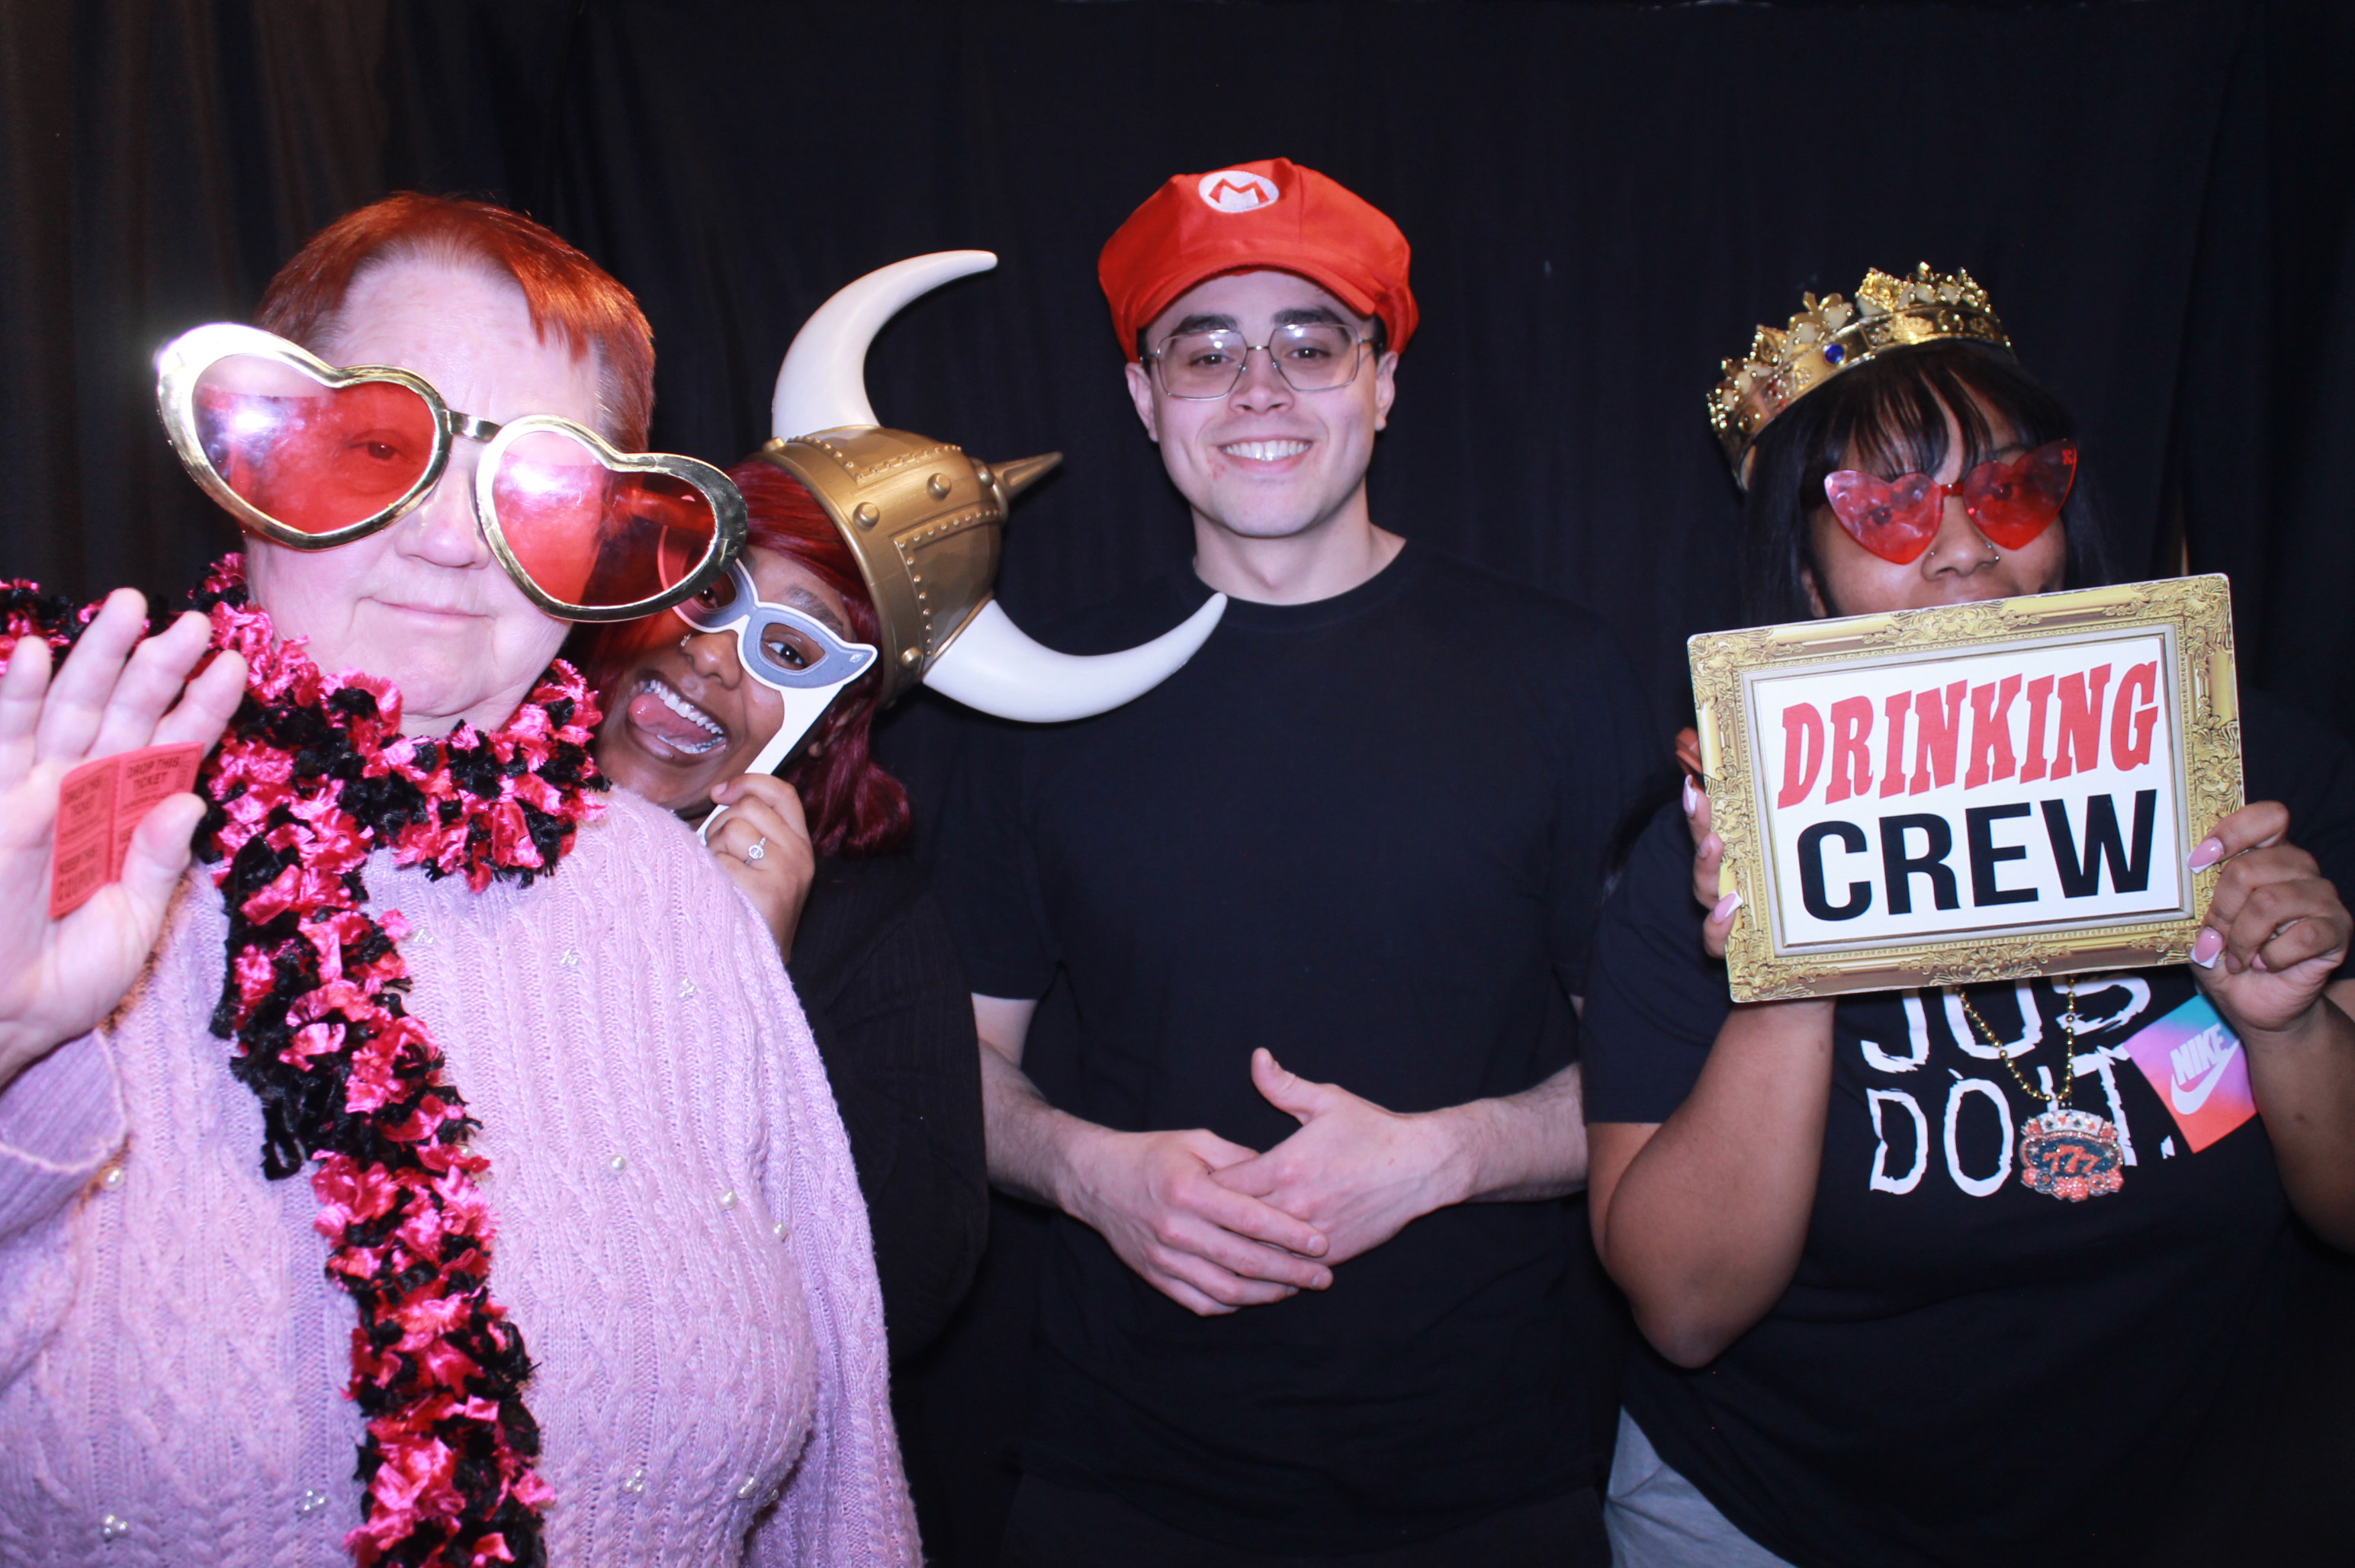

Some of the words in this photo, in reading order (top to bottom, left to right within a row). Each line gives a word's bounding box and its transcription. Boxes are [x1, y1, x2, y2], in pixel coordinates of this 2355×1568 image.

[1209, 178, 1270, 204] M
[1778, 660, 2159, 809] DRINKING
[1797, 789, 2157, 922] CREW
[2170, 1023, 2225, 1087] NIKE
[2043, 1144, 2101, 1174] 777
